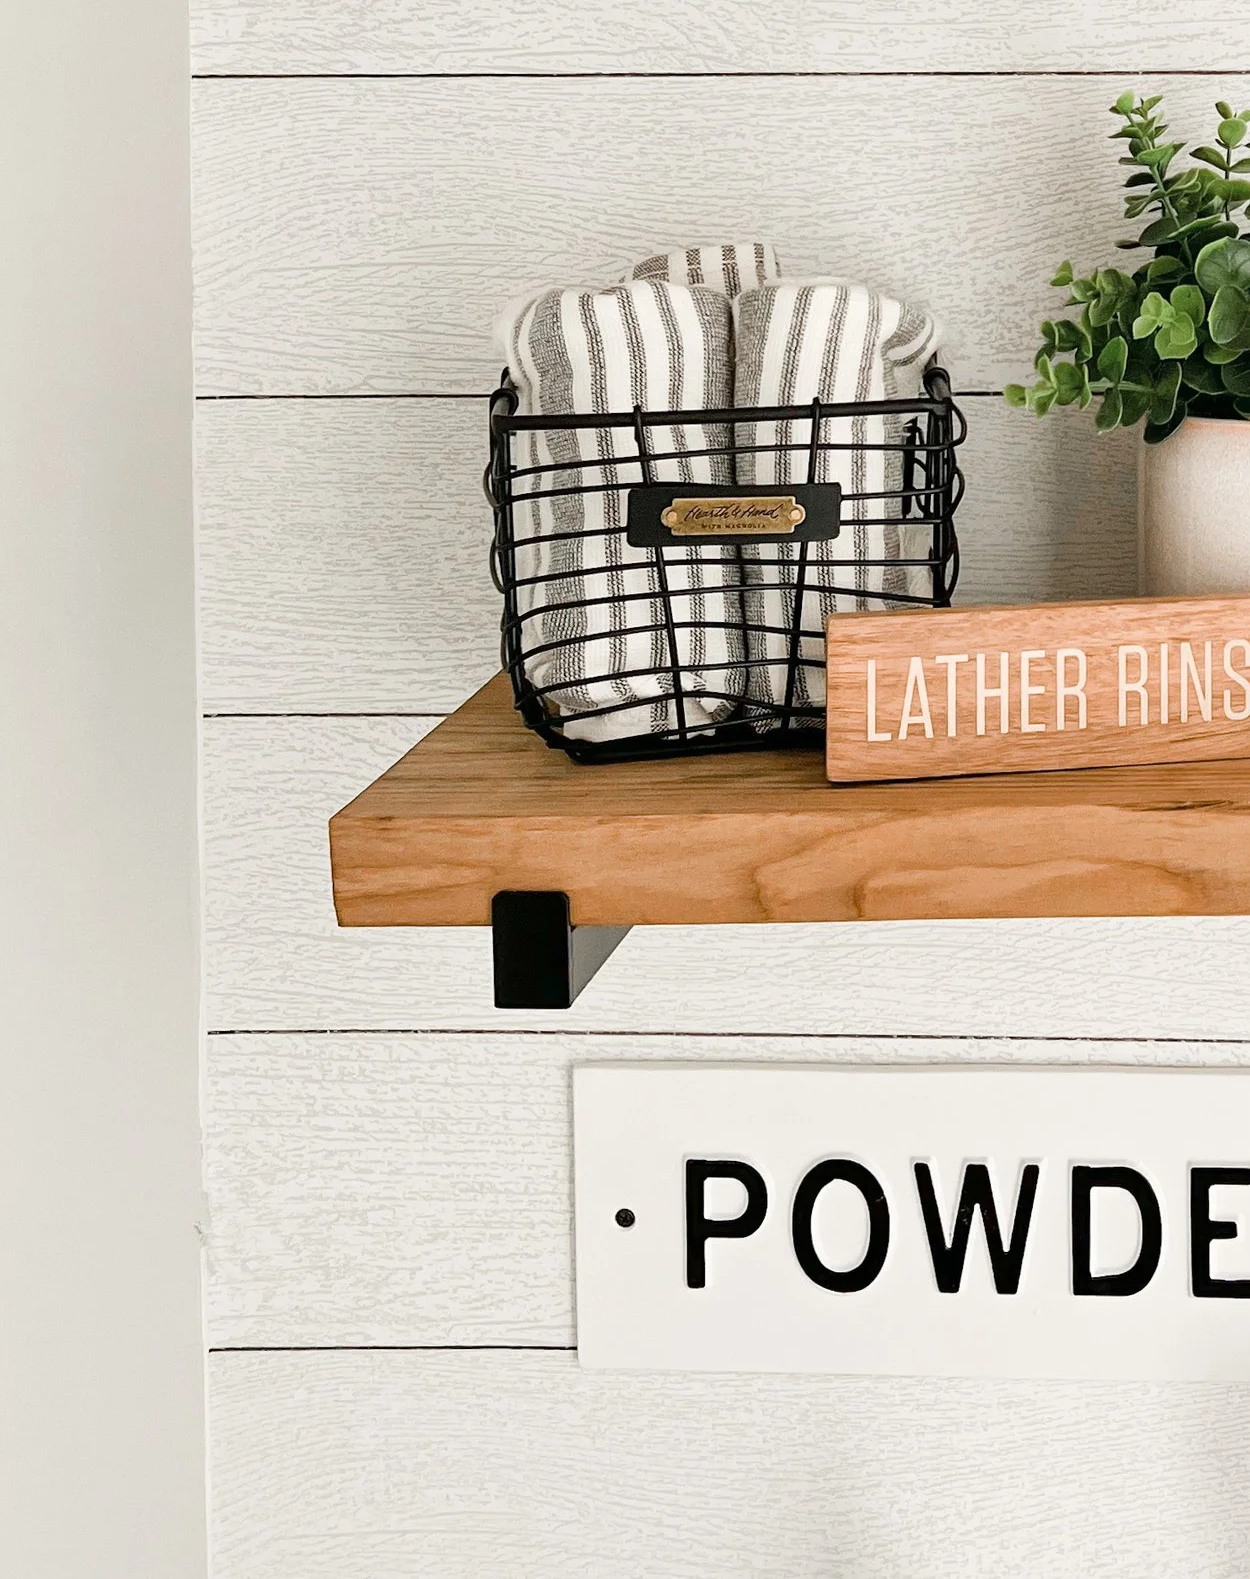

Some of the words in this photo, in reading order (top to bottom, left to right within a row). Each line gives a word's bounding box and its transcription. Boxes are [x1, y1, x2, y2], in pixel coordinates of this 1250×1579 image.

[684, 502, 735, 521] Hearth
[731, 505, 741, 519] &
[740, 503, 784, 519] Hand
[866, 647, 1087, 742] LATHER
